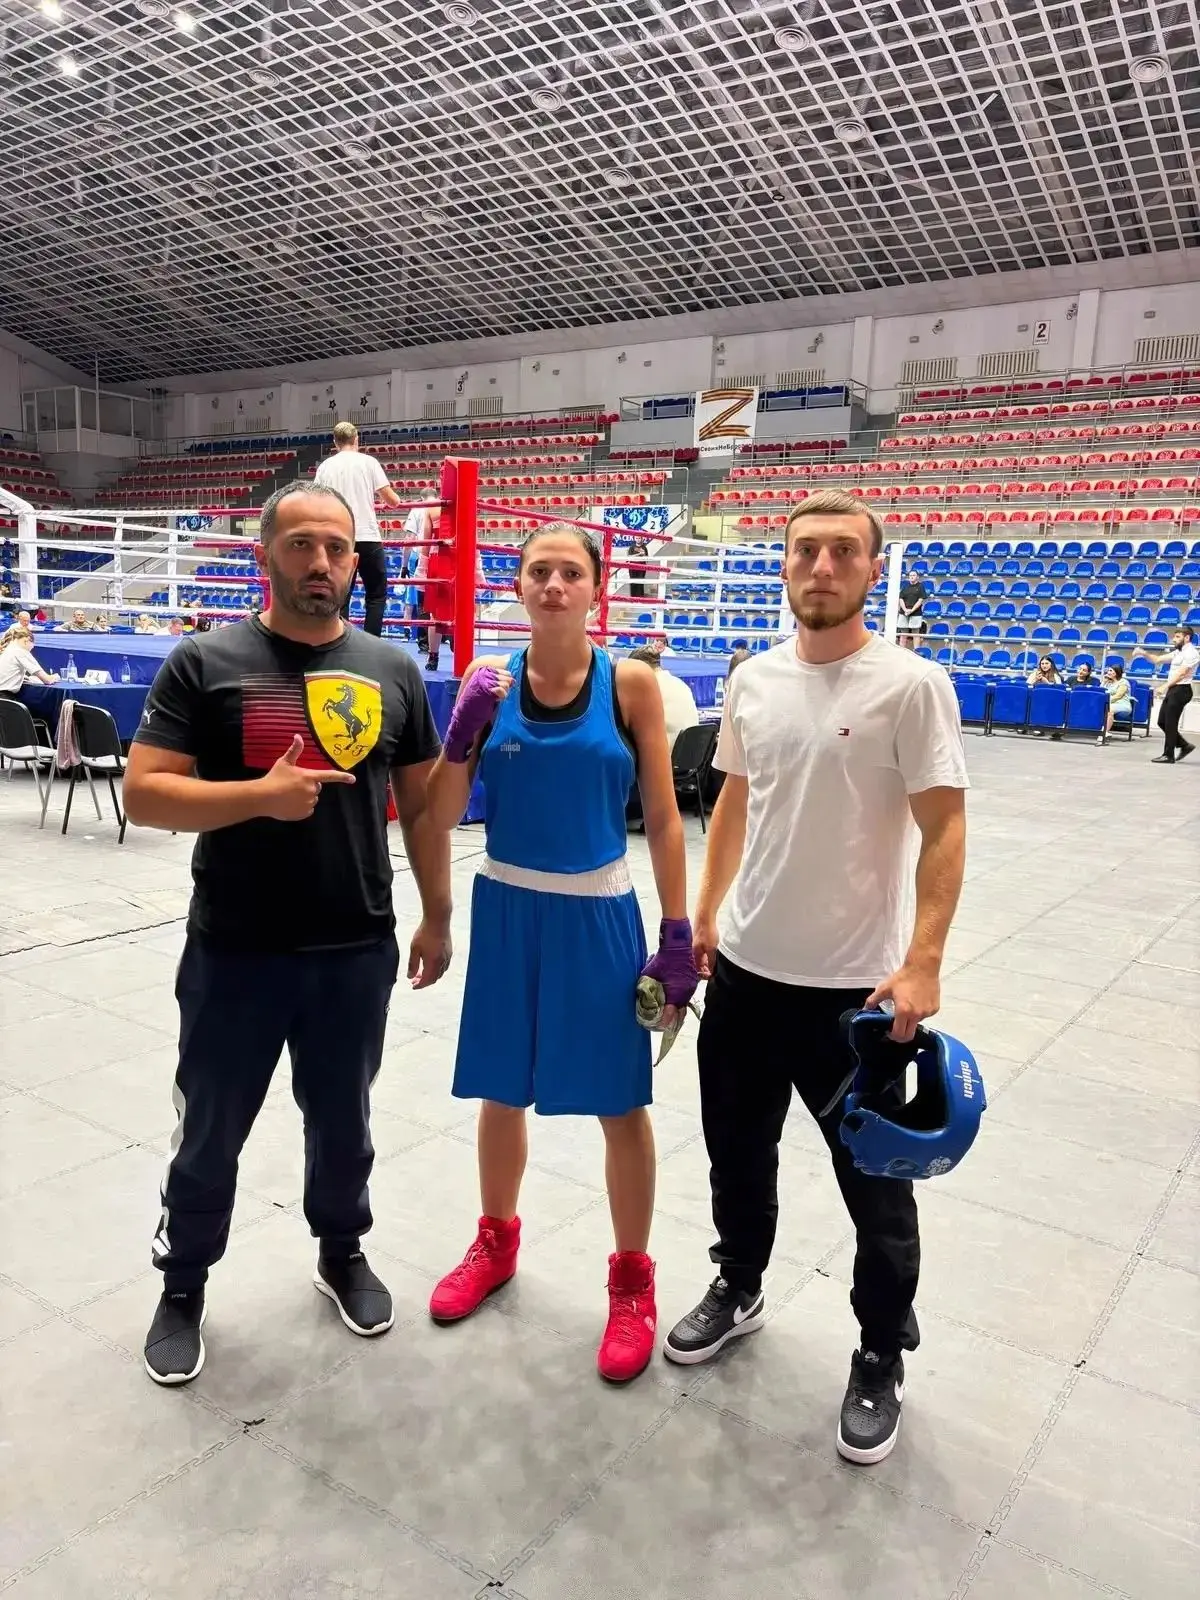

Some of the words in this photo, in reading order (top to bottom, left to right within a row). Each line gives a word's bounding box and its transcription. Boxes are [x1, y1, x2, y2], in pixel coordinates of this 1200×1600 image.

[1036, 323, 1047, 338] 2
[457, 380, 463, 392] 3
[699, 388, 754, 441] Z
[650, 521, 656, 530] 2
[333, 743, 342, 756] S
[352, 744, 368, 757] F
[960, 1060, 975, 1099] clinch
